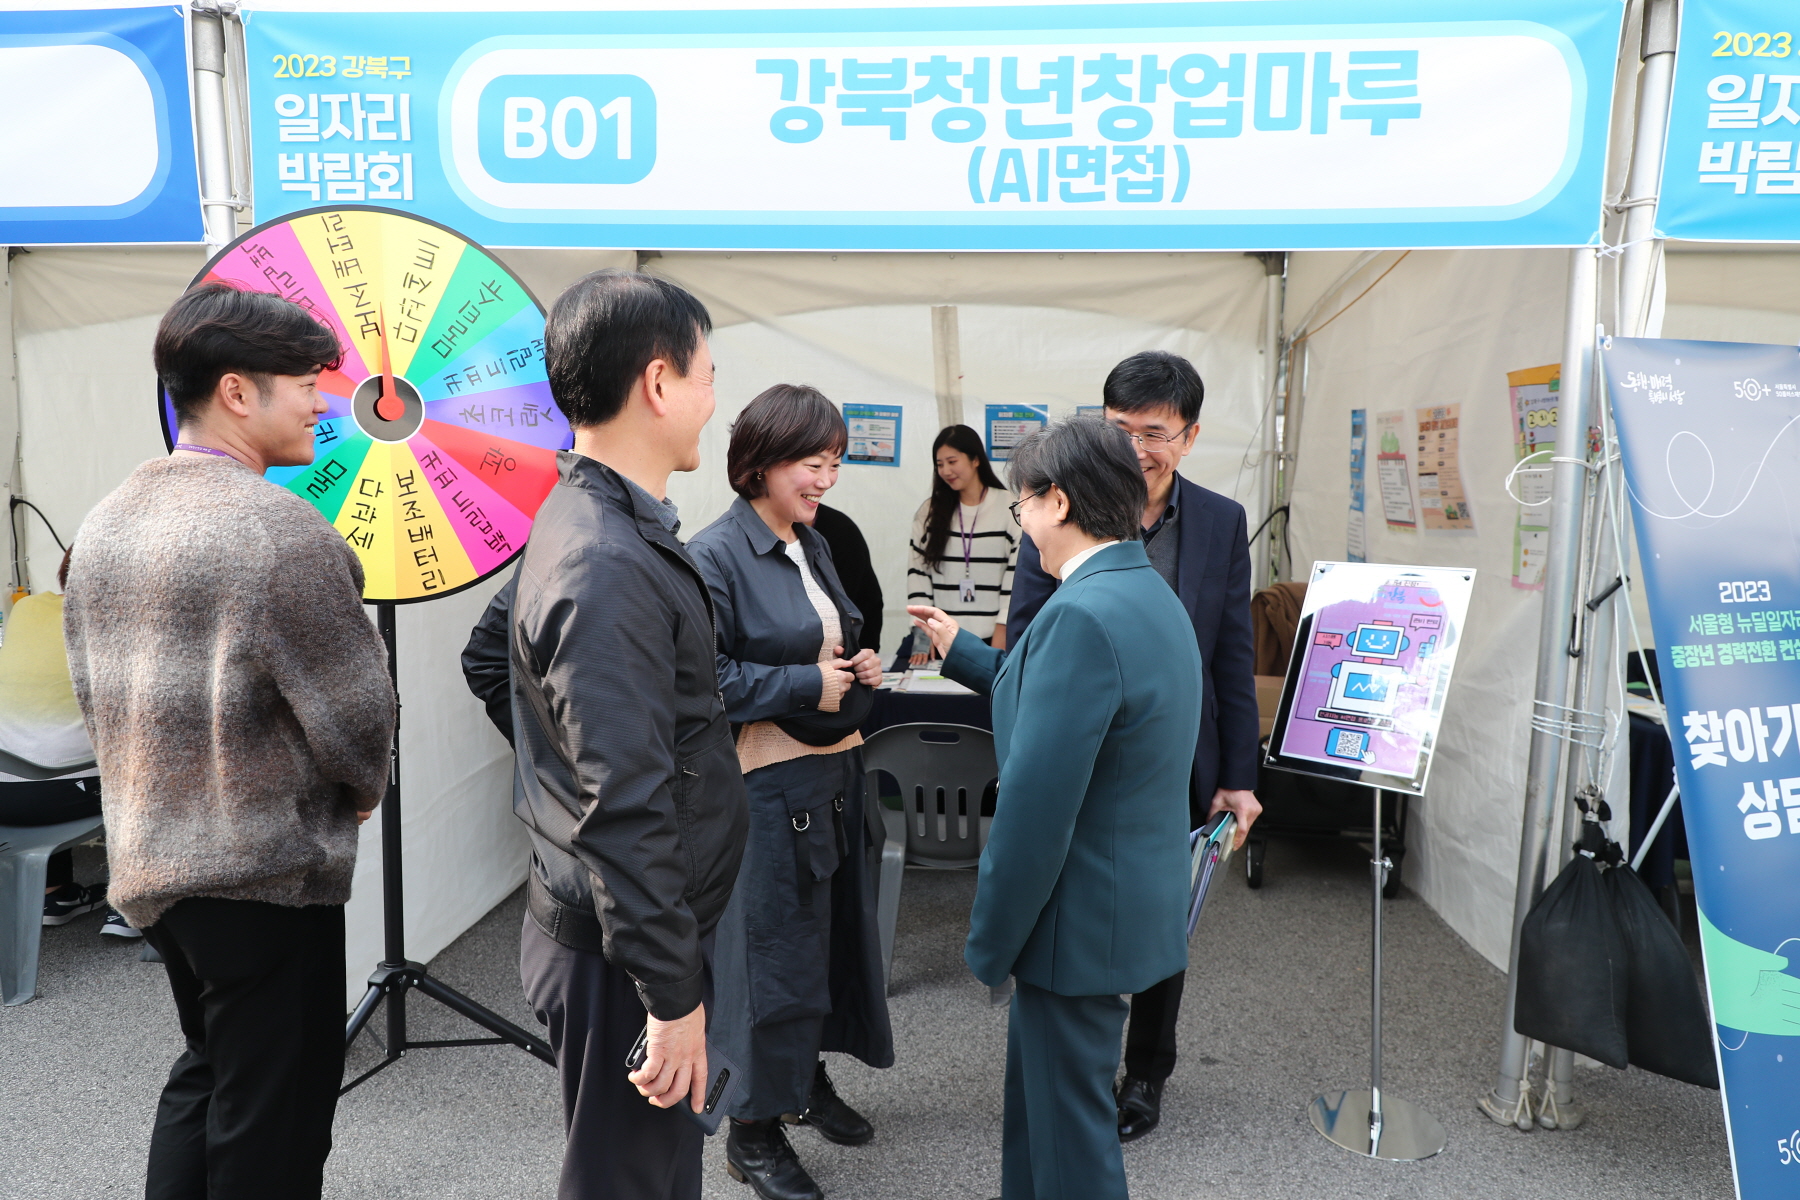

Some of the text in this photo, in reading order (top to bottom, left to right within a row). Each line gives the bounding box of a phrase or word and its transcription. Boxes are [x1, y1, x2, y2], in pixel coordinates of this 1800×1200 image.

[272, 54, 412, 80] 2023 강북구
[1711, 31, 1793, 58] 2023
[273, 92, 412, 143] 일자리
[755, 49, 1422, 144] 강북청년창업마루
[502, 95, 634, 160] B01
[278, 150, 415, 202] 박람회
[967, 143, 1191, 205] (AI면접)
[320, 213, 382, 340] 보조배터리
[392, 238, 441, 344] 다과세트
[430, 279, 504, 360] 물티슈
[479, 446, 517, 476] 꽝
[346, 477, 385, 550] 다과세
[396, 469, 446, 591] 보조배터리
[1718, 580, 1772, 604] 2023
[1688, 612, 1735, 636] 서울형
[1670, 643, 1716, 669] 중장년
[1716, 640, 1778, 666] 경력전환
